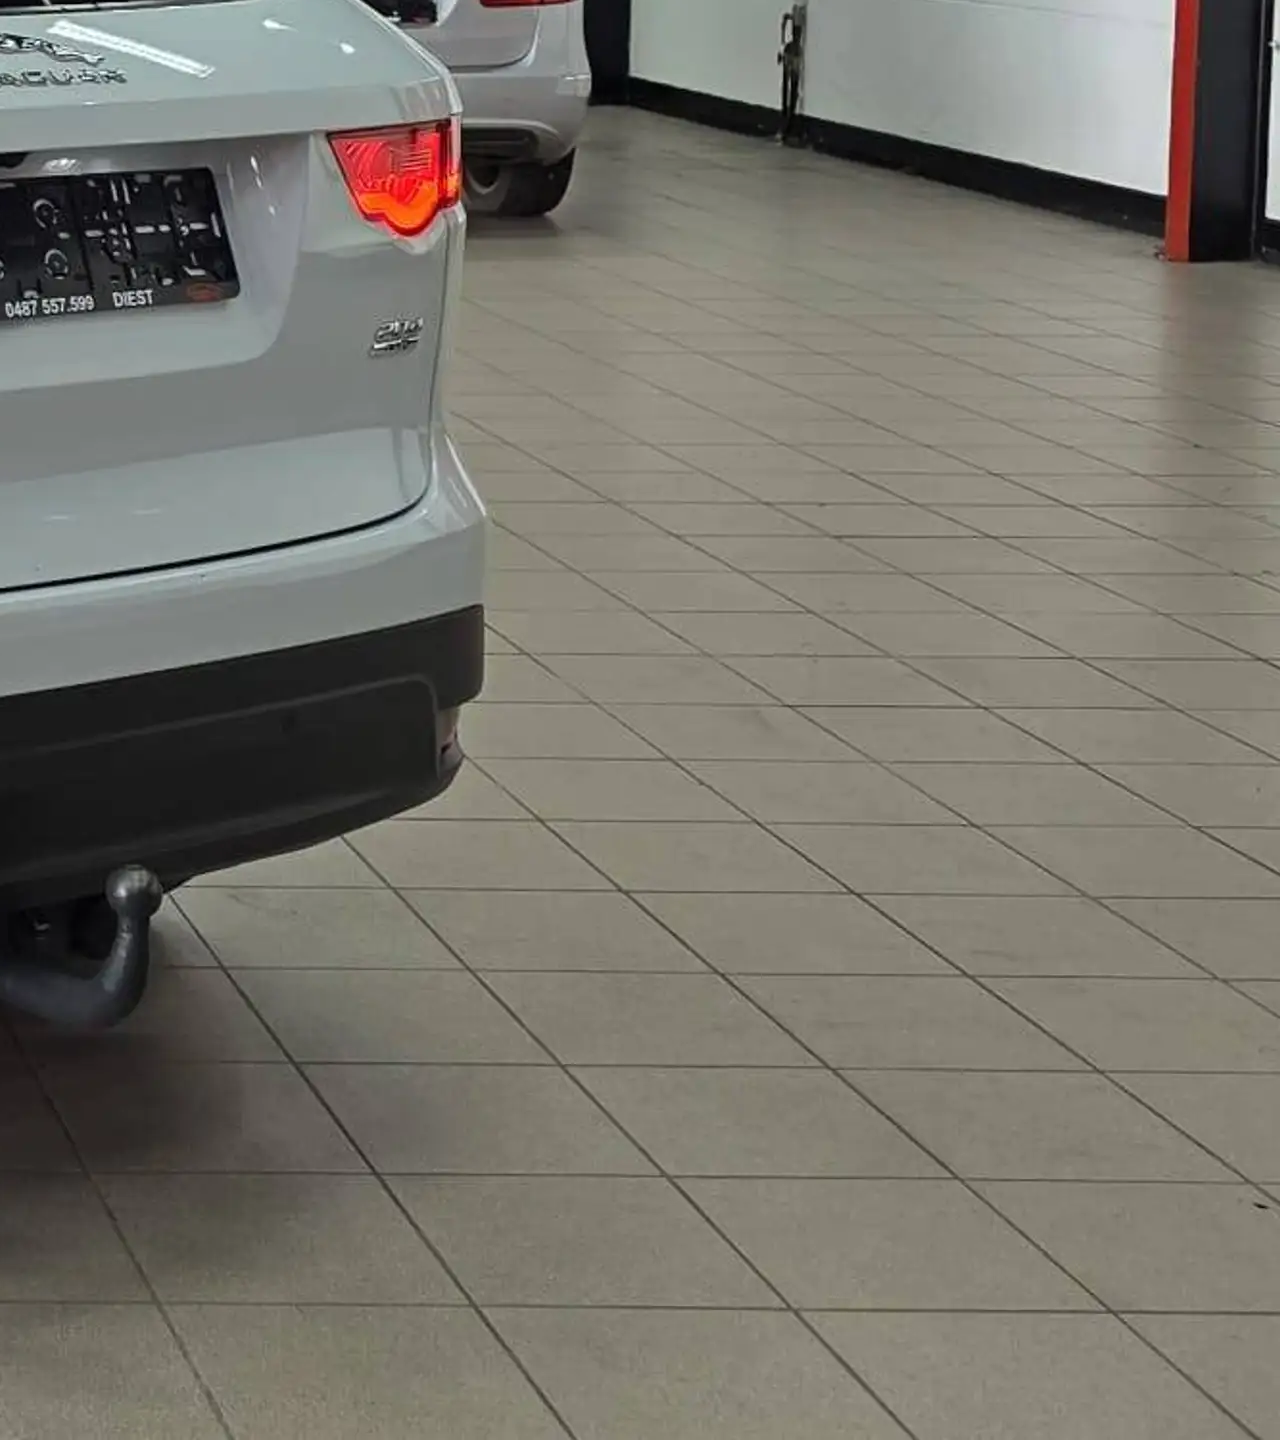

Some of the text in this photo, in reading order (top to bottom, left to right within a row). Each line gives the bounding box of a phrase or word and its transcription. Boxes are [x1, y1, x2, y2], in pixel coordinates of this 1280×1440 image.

[4, 299, 38, 318] 0487
[41, 295, 95, 314] 557.599
[112, 289, 155, 309] DIEST
